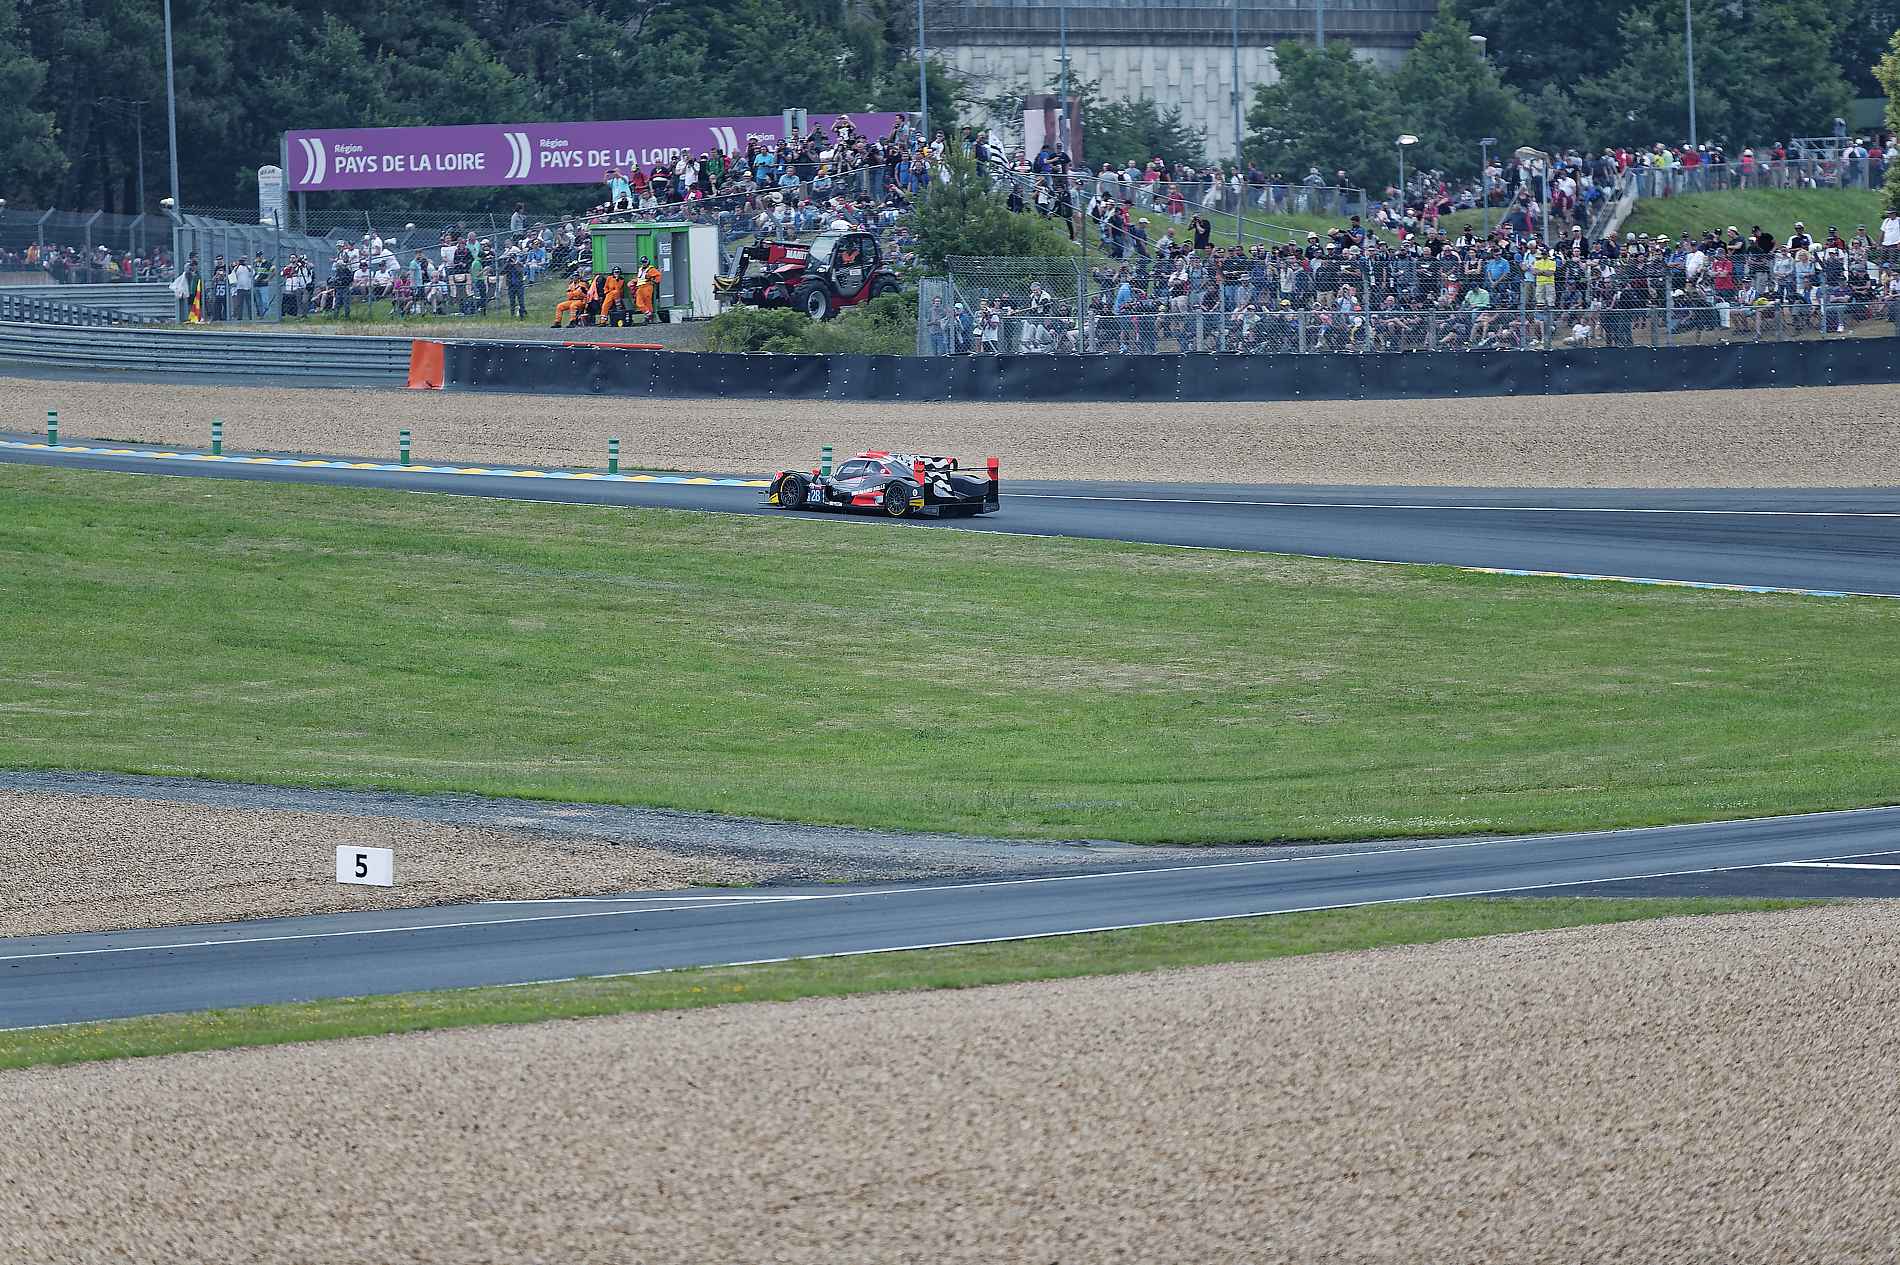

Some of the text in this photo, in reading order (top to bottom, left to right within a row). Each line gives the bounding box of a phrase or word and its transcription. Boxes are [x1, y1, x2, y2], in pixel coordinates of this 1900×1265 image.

[334, 144, 363, 154] Région
[540, 138, 569, 149] Région
[335, 153, 486, 174] PAYS DE LA LOIRE
[540, 147, 691, 168] PAYS DE LA LOIR
[811, 489, 821, 502] 28
[354, 853, 368, 878] 5
